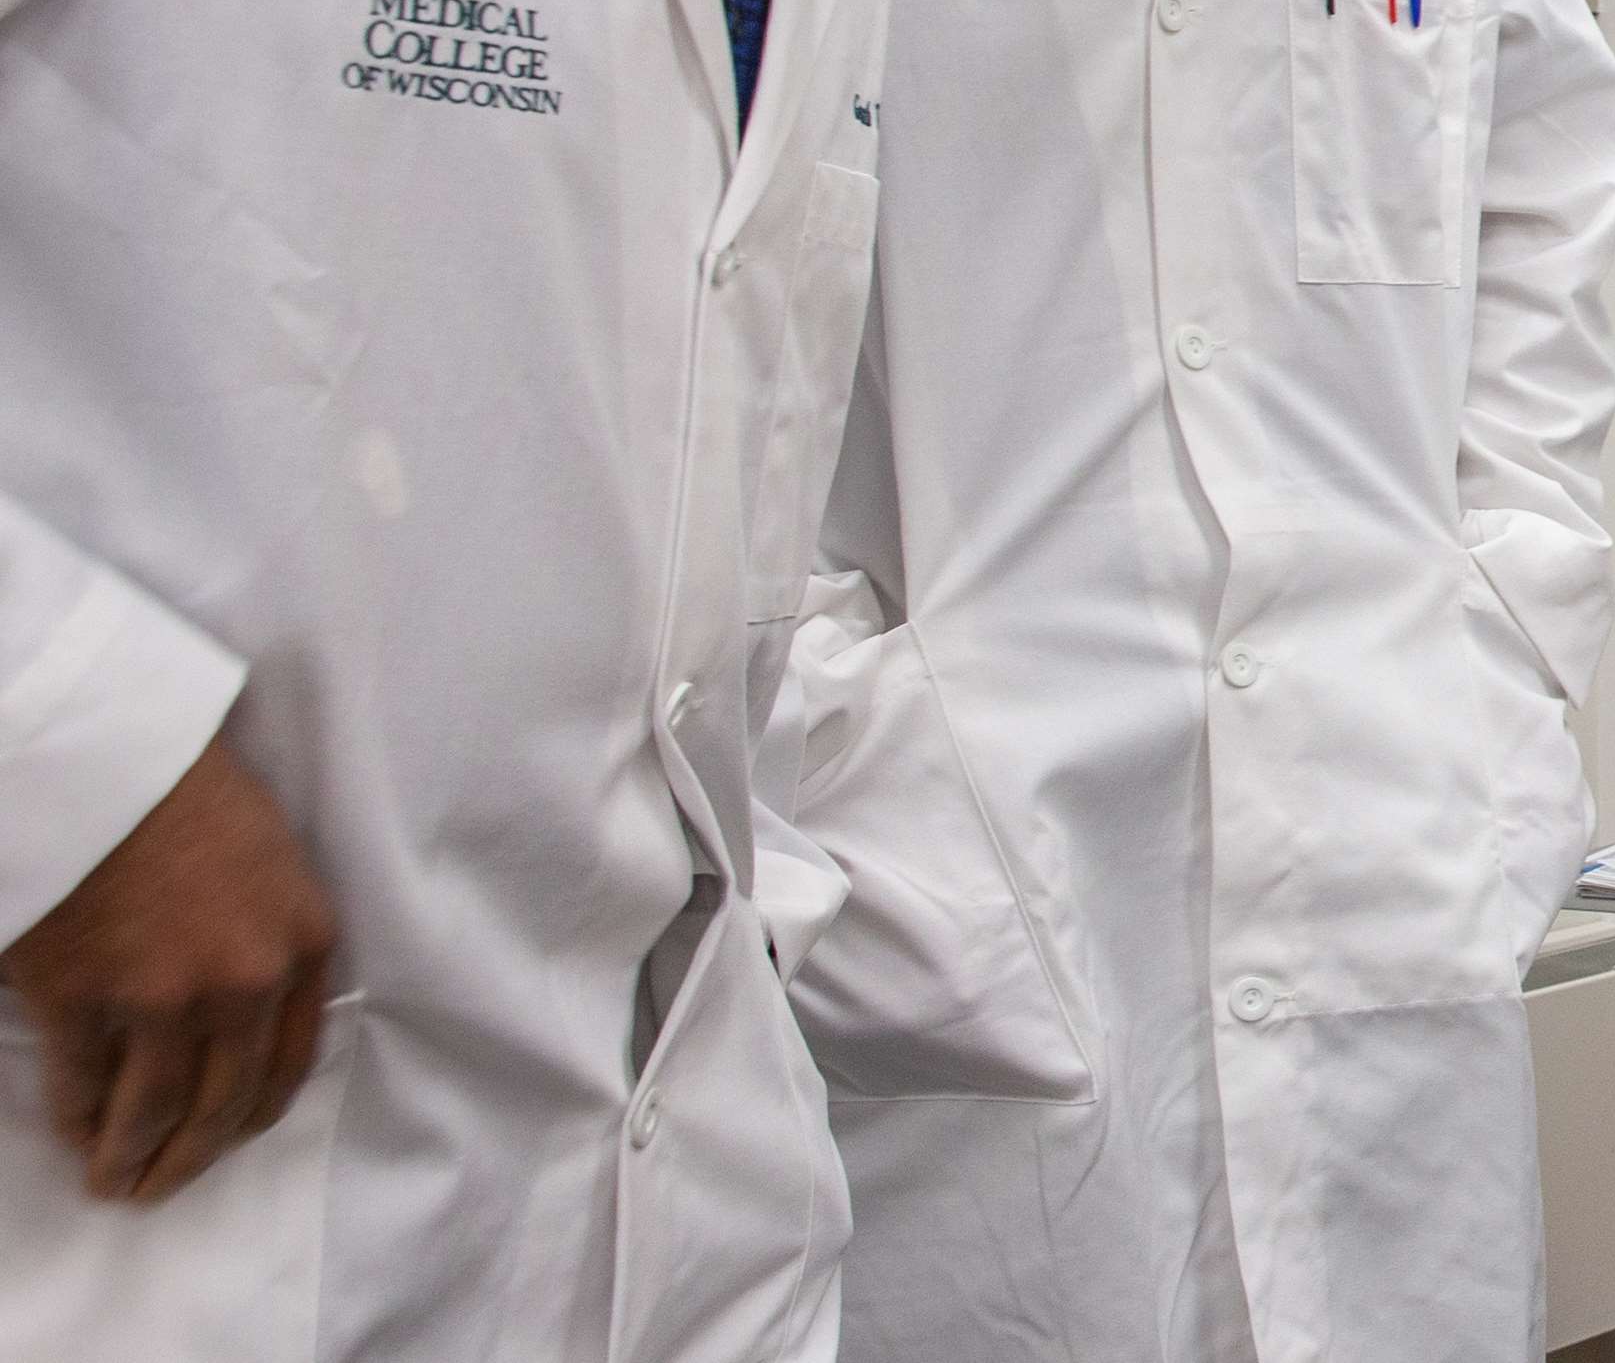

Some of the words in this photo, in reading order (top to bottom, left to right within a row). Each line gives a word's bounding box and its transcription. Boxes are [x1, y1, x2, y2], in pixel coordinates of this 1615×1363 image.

[365, 19, 549, 80] COLLEGE
[342, 62, 384, 91] OF
[384, 69, 563, 115] WISCONSIN
